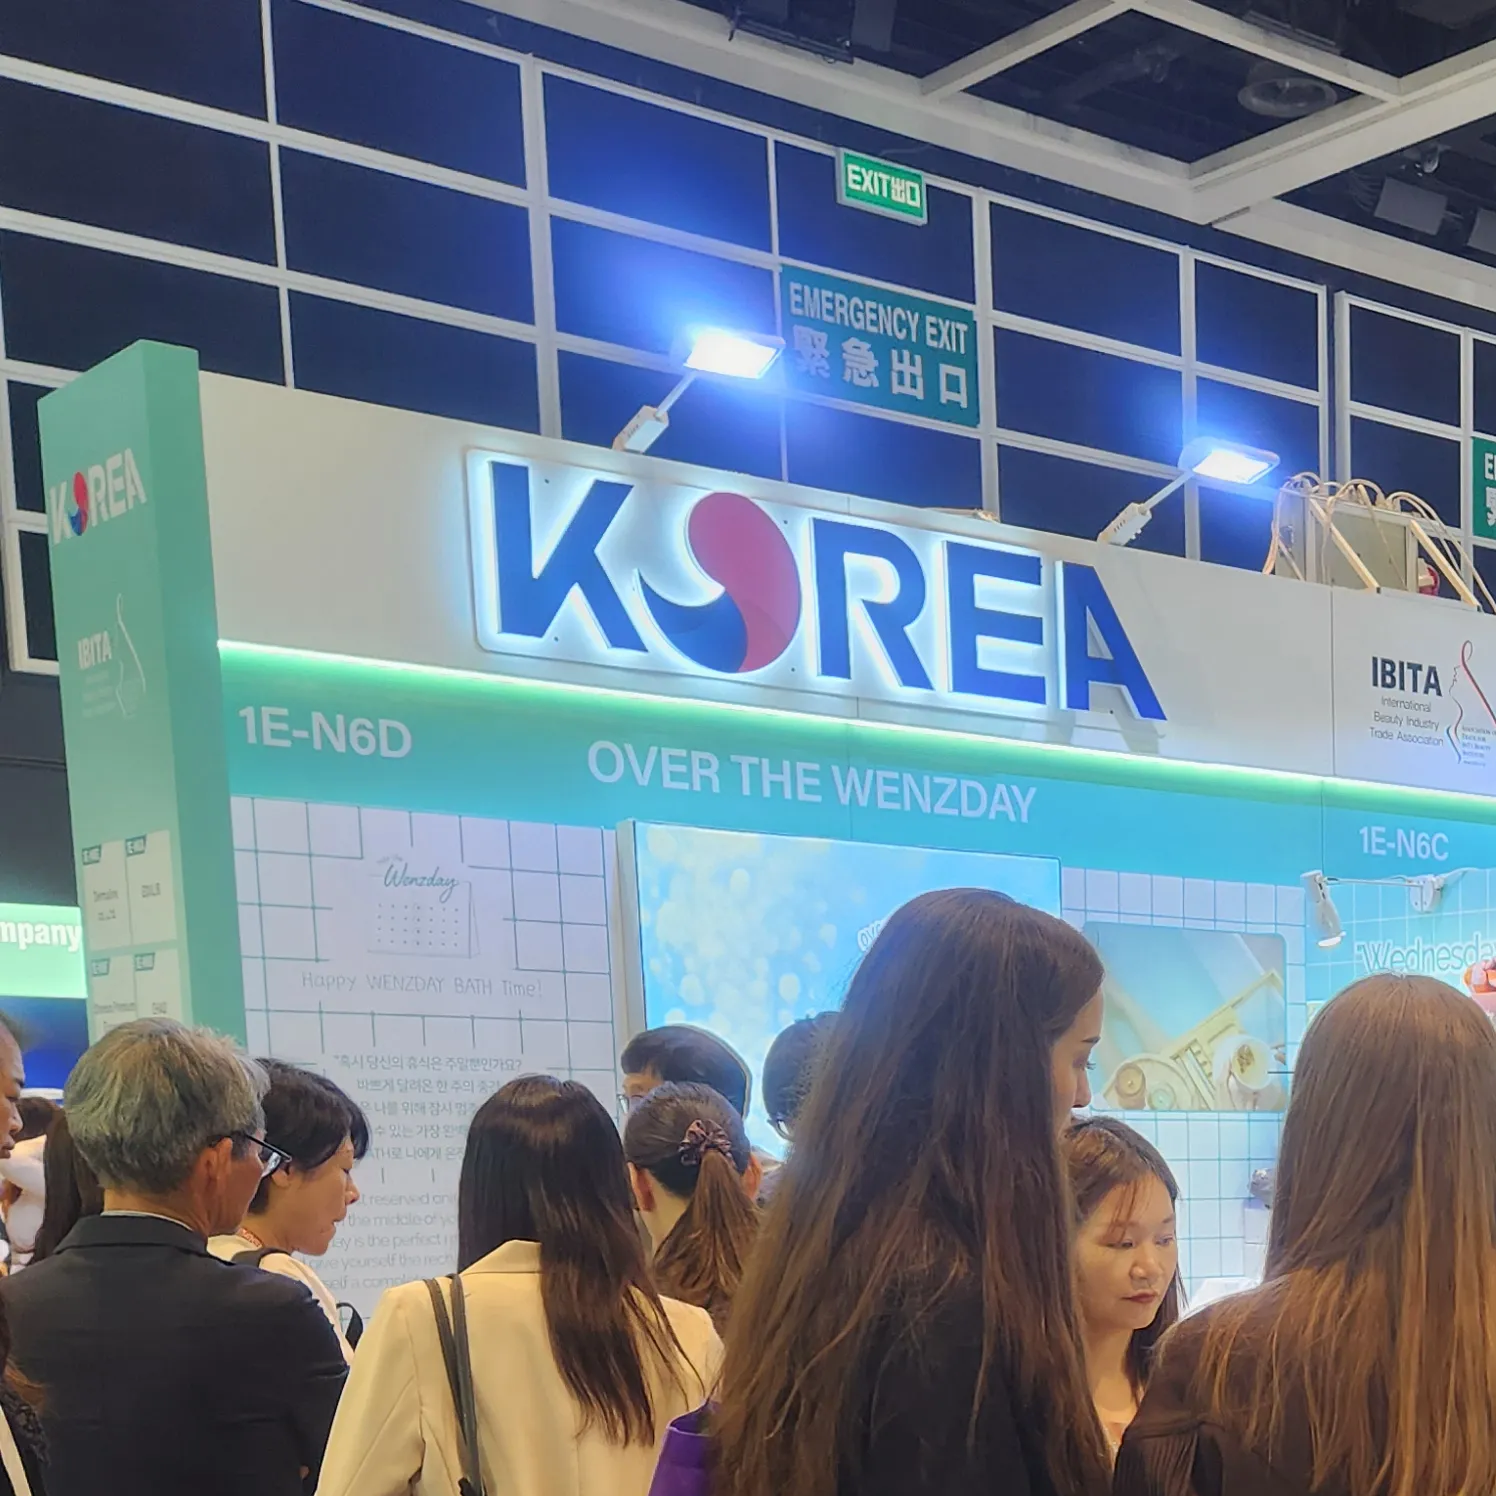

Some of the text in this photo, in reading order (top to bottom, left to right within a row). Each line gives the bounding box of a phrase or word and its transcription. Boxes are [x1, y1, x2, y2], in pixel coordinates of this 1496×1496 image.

[789, 281, 968, 355] EMERGENCY EXIT
[793, 324, 968, 409] 緊急出口
[49, 448, 148, 544] KOREA
[489, 459, 1167, 721] KOREA
[1372, 656, 1443, 697] IBITA
[1373, 711, 1440, 732] Beauty Industry
[1381, 695, 1432, 713] International
[1369, 727, 1444, 747] Trade Association
[238, 705, 1037, 824] 1E-N6D OVER THE WENZDAY
[1359, 826, 1449, 861] 1E-N6C
[384, 862, 460, 904] Wenzday
[301, 971, 543, 998] Happy WENZDAY BATH Time!
